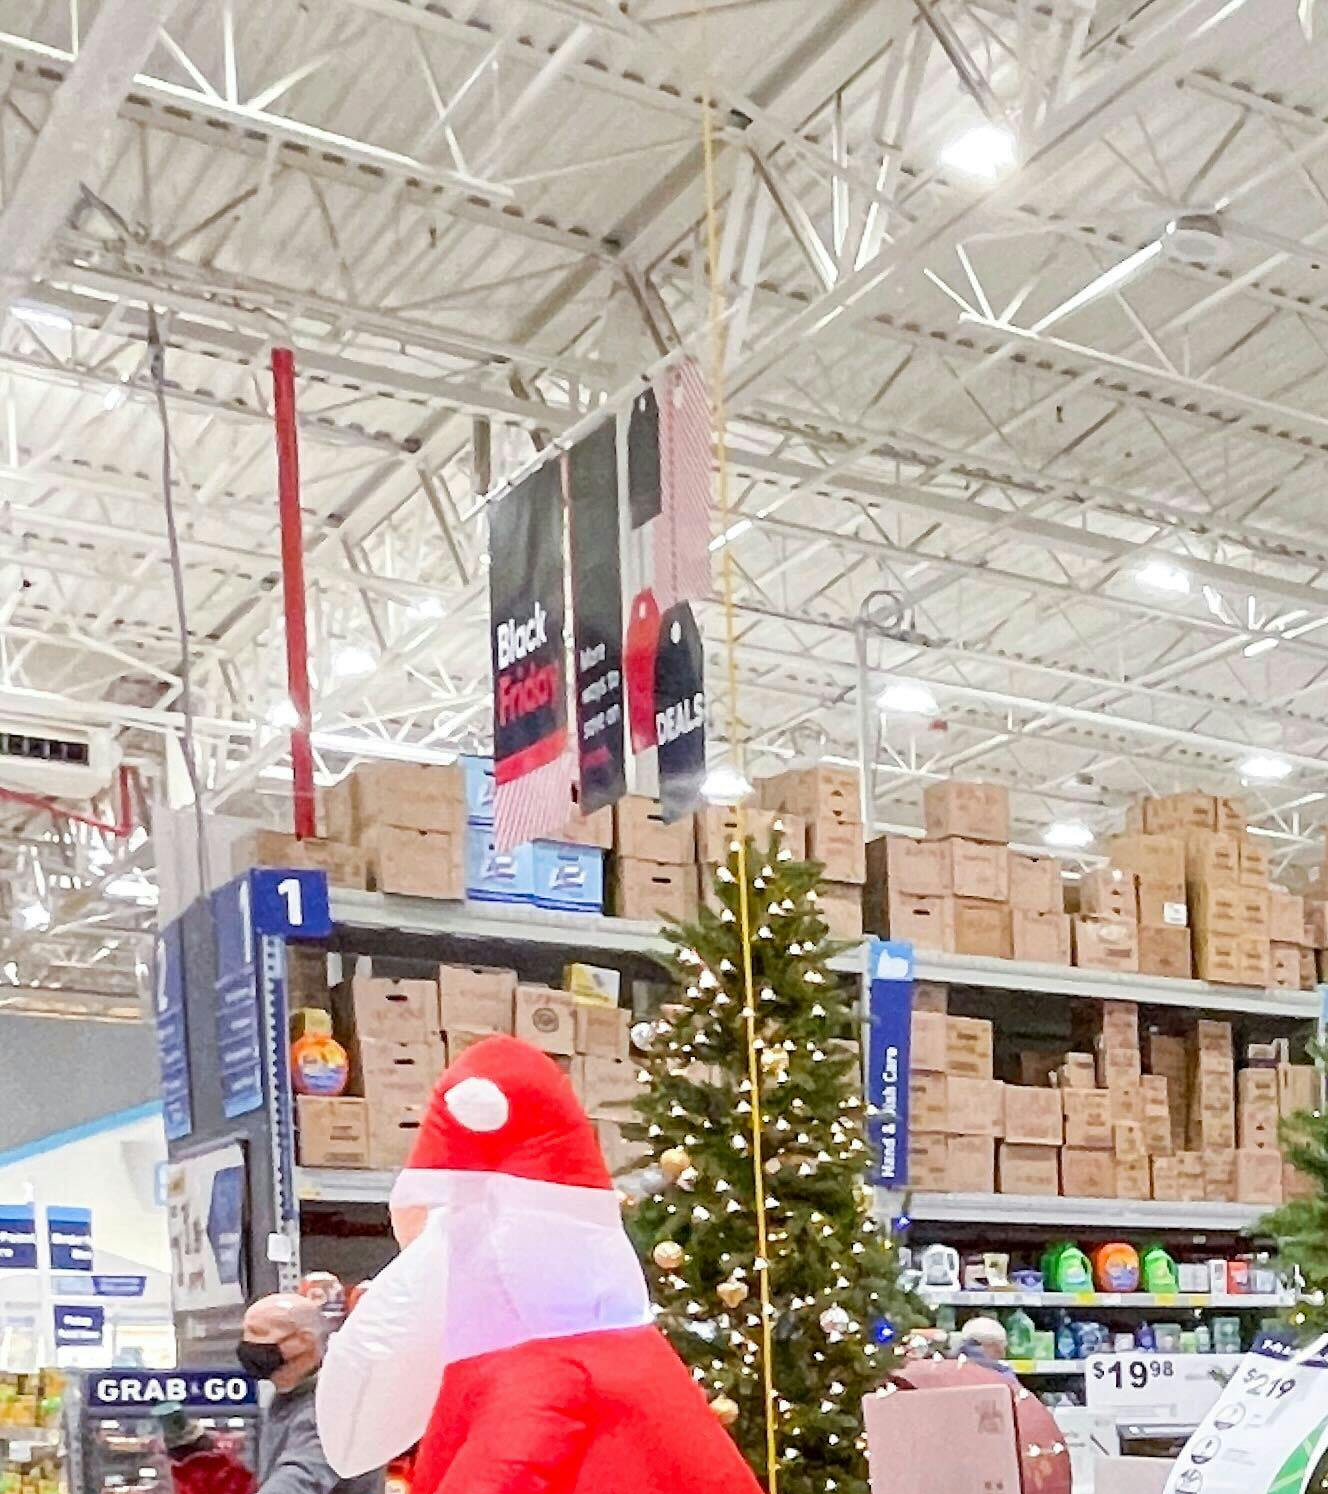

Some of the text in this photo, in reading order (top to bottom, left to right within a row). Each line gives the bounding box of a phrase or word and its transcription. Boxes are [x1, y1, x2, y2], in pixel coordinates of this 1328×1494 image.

[497, 601, 547, 670] Black
[498, 658, 558, 727] Friday
[656, 692, 705, 745] DEALS
[278, 879, 303, 927] 1
[97, 1378, 187, 1402] GRAB
[203, 1378, 248, 1401] GO
